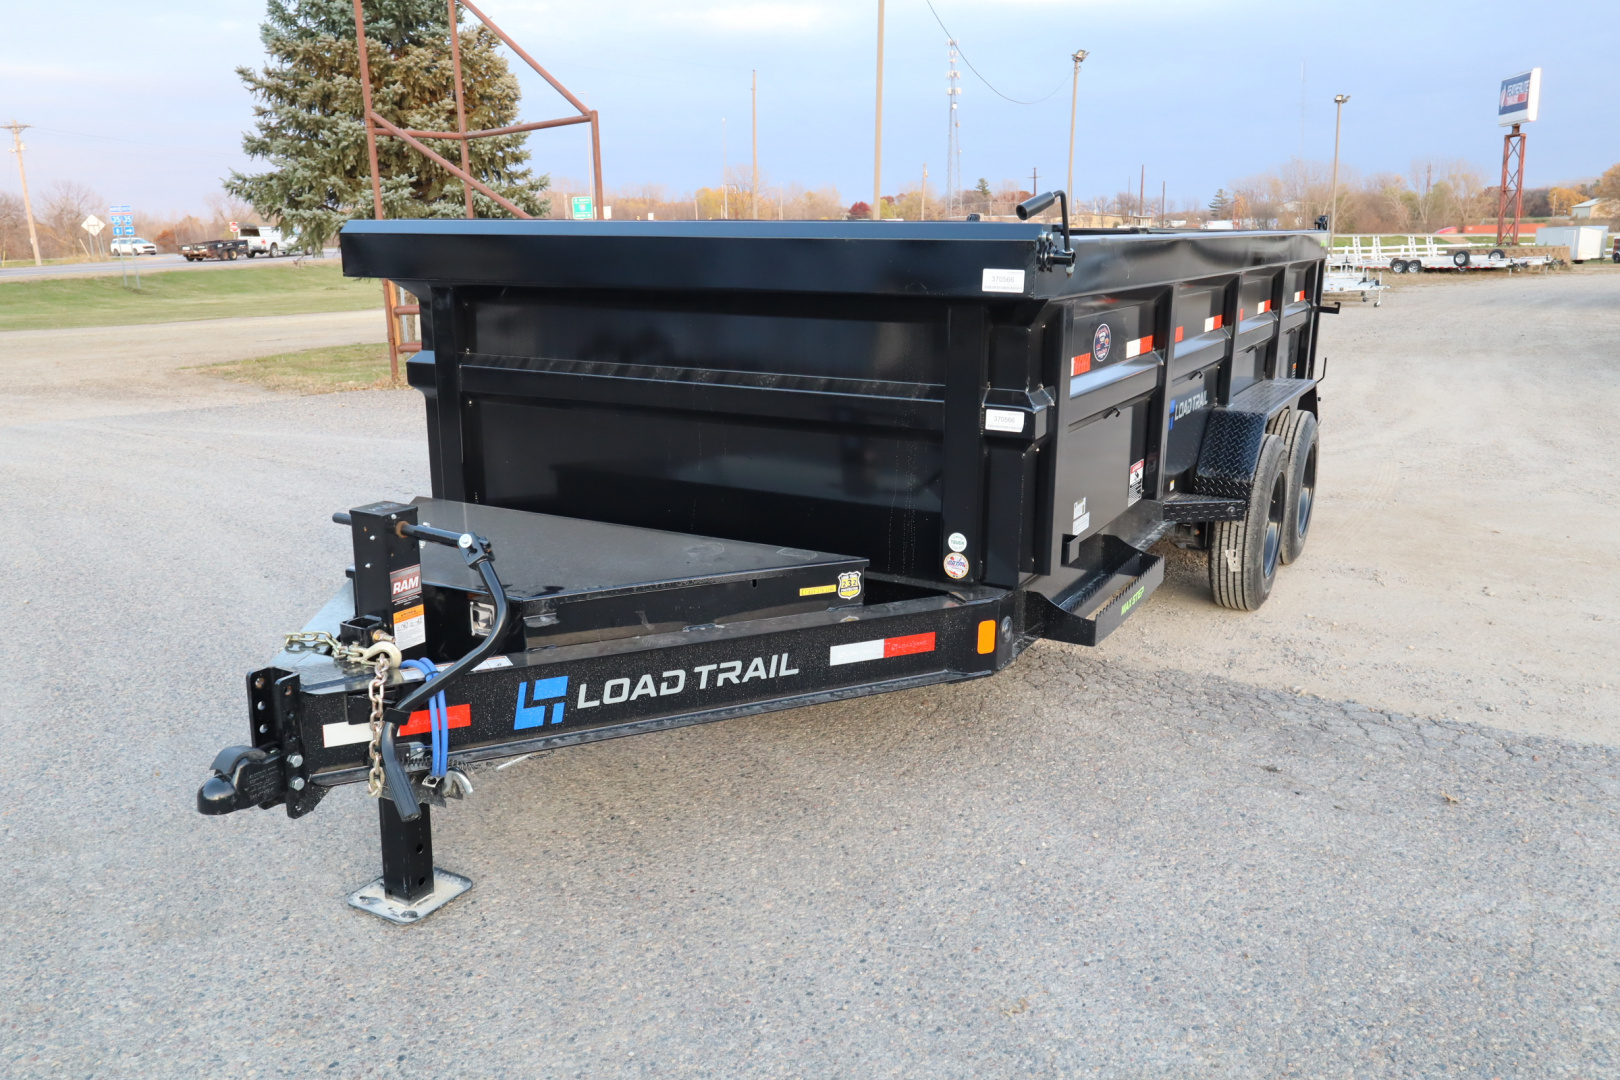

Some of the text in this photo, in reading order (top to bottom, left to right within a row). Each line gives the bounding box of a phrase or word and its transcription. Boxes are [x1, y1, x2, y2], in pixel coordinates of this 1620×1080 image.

[123, 215, 132, 223] 35
[991, 275, 1015, 283] 370566
[1174, 389, 1208, 421] LOAD TRAIL
[993, 415, 1016, 424] 370566
[392, 575, 420, 595] RAM
[842, 579, 857, 588] 232
[576, 653, 800, 709] LOAD TRAIL
